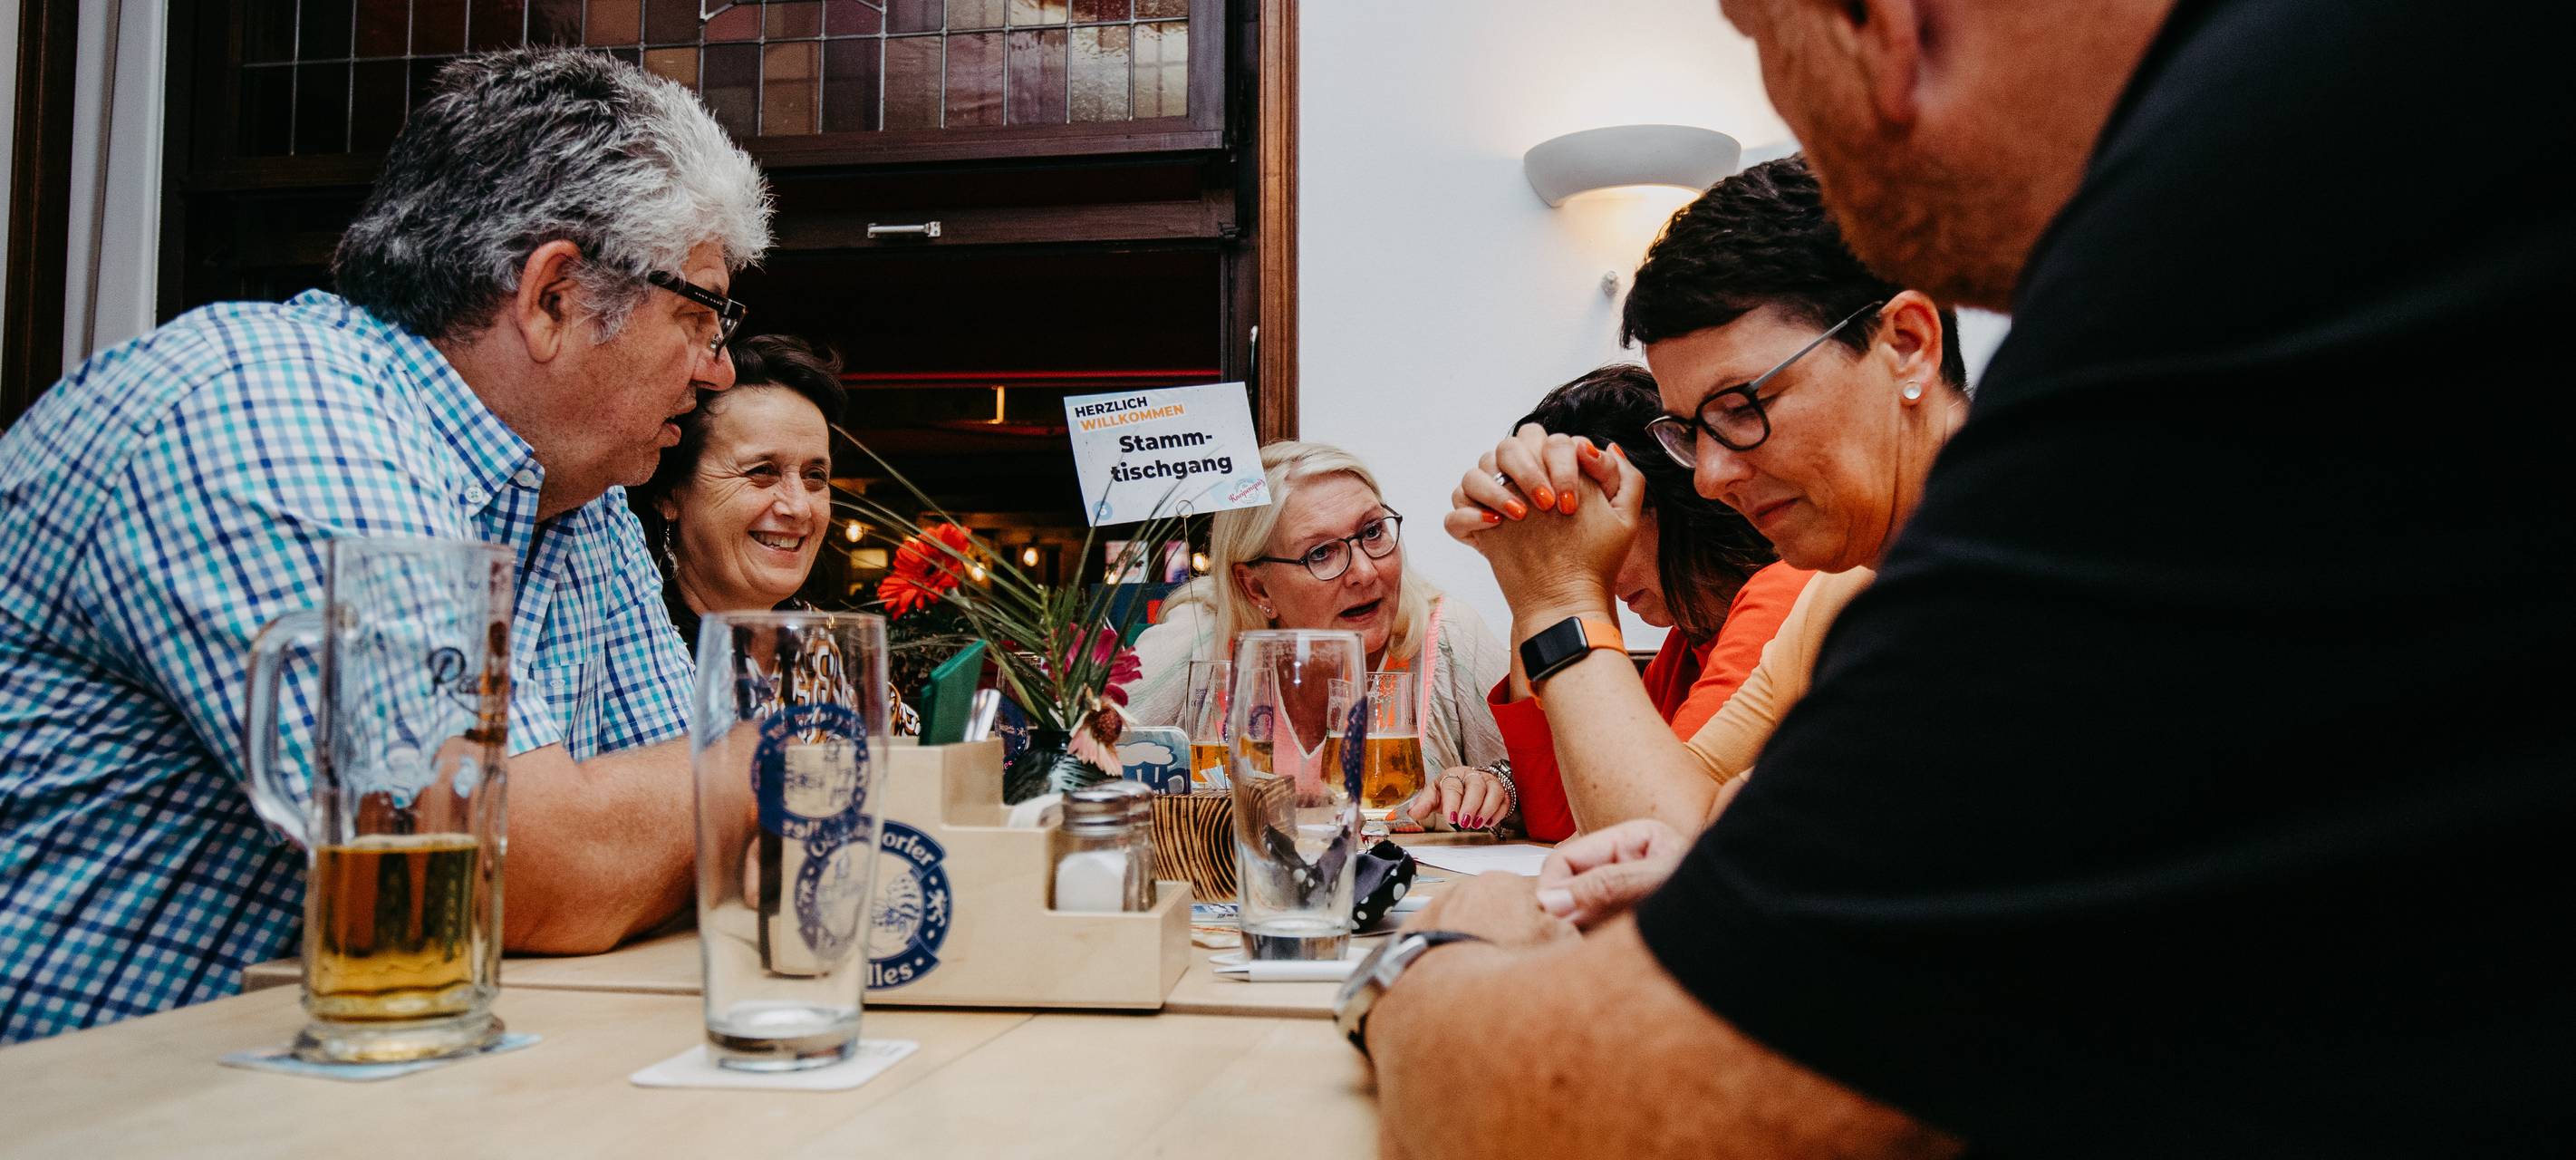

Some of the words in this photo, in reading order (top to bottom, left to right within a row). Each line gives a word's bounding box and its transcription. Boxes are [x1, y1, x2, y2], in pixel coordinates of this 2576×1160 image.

[1075, 396, 1148, 418] HERZLICH
[1080, 404, 1185, 431] WILLKOMMEN
[1119, 430, 1213, 453] Stamm-
[1111, 456, 1233, 482] tischgang
